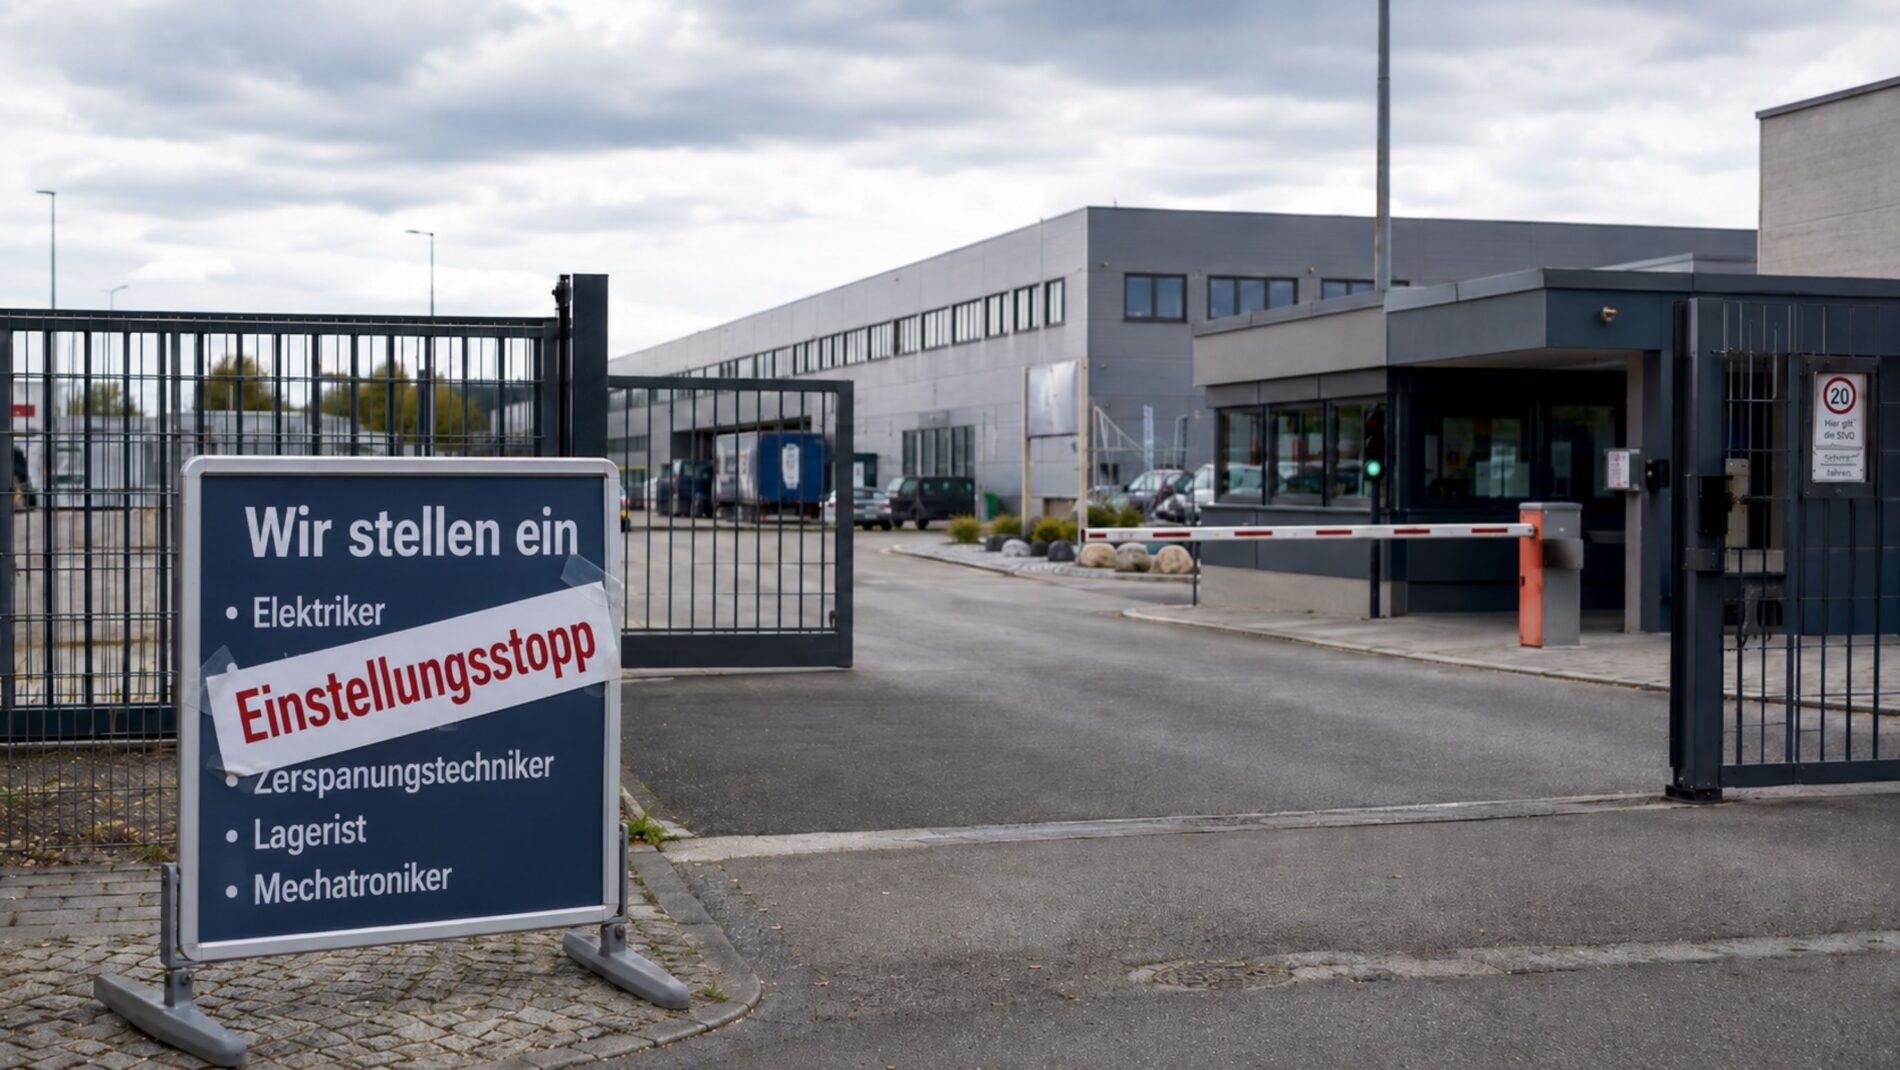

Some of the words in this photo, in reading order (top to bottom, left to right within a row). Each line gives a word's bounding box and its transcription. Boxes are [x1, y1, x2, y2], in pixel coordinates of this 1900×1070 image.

[1830, 387, 1850, 405] 20
[1824, 419, 1840, 428] Hier
[245, 505, 332, 557] Wir
[349, 505, 500, 557] stellen
[517, 506, 578, 556] ein
[254, 594, 386, 628] Elektriker
[235, 621, 596, 744] Einstellungsstopp
[254, 749, 555, 799] Zerspanungstechniker
[255, 813, 367, 856] Lagerist
[255, 862, 453, 905] Mechatroniker
